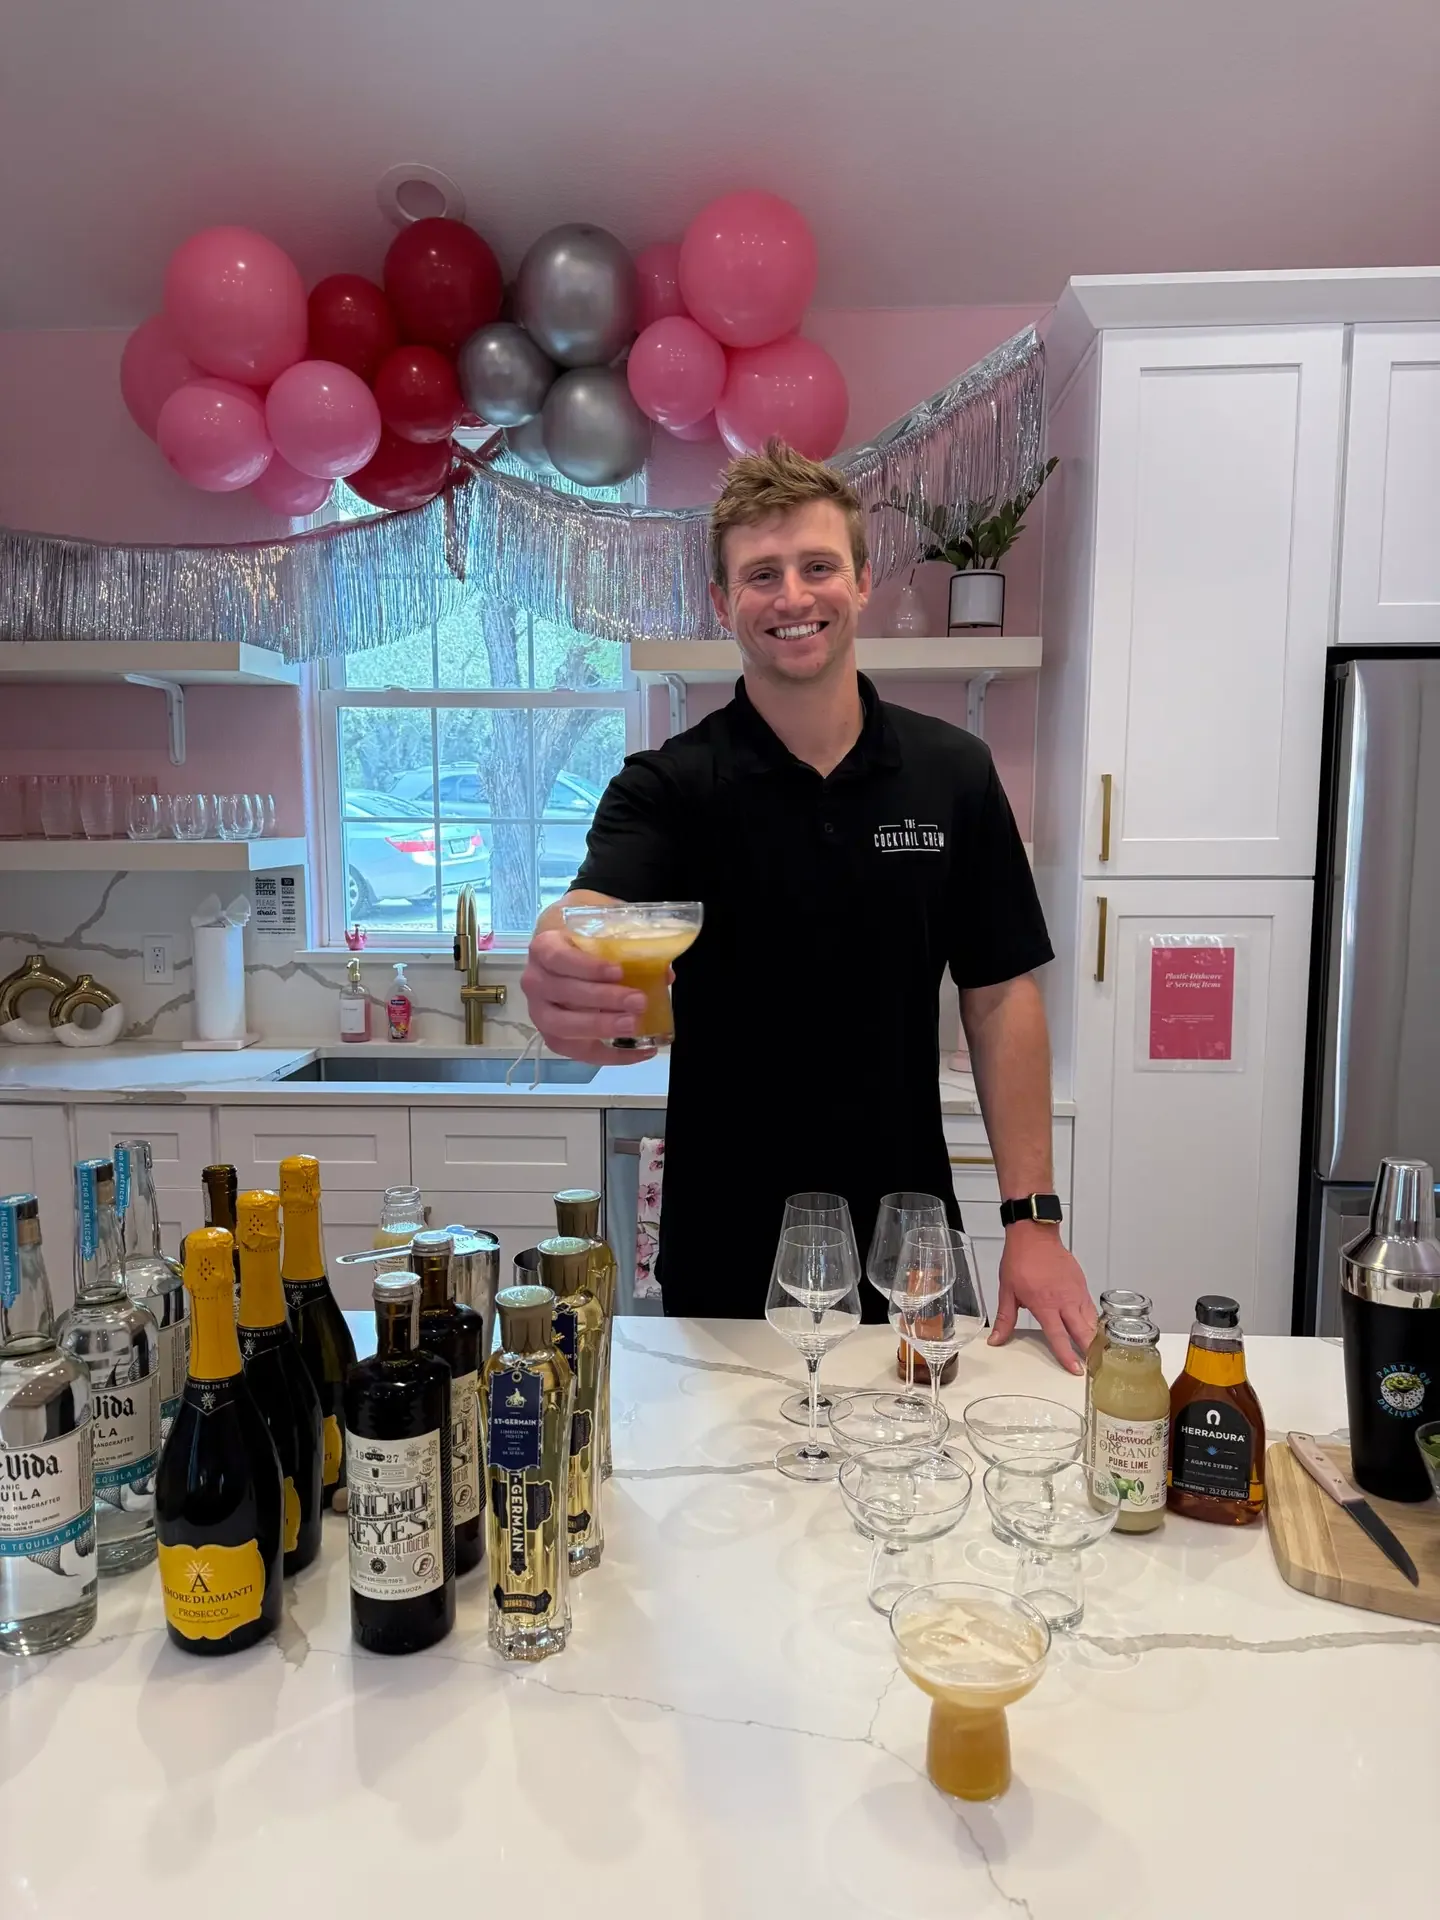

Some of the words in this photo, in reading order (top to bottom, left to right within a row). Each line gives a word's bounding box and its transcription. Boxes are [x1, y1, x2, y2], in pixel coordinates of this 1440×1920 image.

[904, 819, 916, 829] THE
[874, 832, 919, 847] COCKTAIL
[923, 832, 945, 847] CREW
[1174, 981, 1201, 989] Serving
[82, 1172, 90, 1197] HECHO
[83, 1199, 90, 1210] EN
[1, 1210, 9, 1238] HECHO
[3, 1242, 10, 1252] EN
[1376, 1364, 1416, 1379] PARTY
[1377, 1398, 1424, 1418] DELIVERY
[494, 1418, 537, 1426] ST-GERMAIN
[1106, 1430, 1153, 1446] Lakewood
[1181, 1425, 1245, 1442] HERRADURA
[356, 1449, 365, 1461] 19
[386, 1454, 400, 1463] 27
[1100, 1440, 1160, 1459] ORGANIC
[5, 1453, 59, 1480] Vida
[1108, 1456, 1129, 1468] PURE
[1130, 1460, 1149, 1469] LIME
[1190, 1458, 1212, 1468] AGAVE
[1213, 1462, 1233, 1470] SYRUP
[95, 1471, 132, 1484] EQUILA
[0, 1489, 41, 1502] UILA
[348, 1482, 427, 1516] ANCHO
[511, 1472, 523, 1552] T-GERMAIN
[348, 1506, 430, 1550] REYES
[12, 1535, 60, 1551] TEQUILA
[362, 1545, 378, 1555] CHILE
[380, 1543, 401, 1555] ANCHO
[402, 1533, 430, 1553] LIQUEUR
[193, 1596, 205, 1604] DI
[207, 1584, 253, 1604] AMANTI
[178, 1607, 229, 1618] PROSECCO
